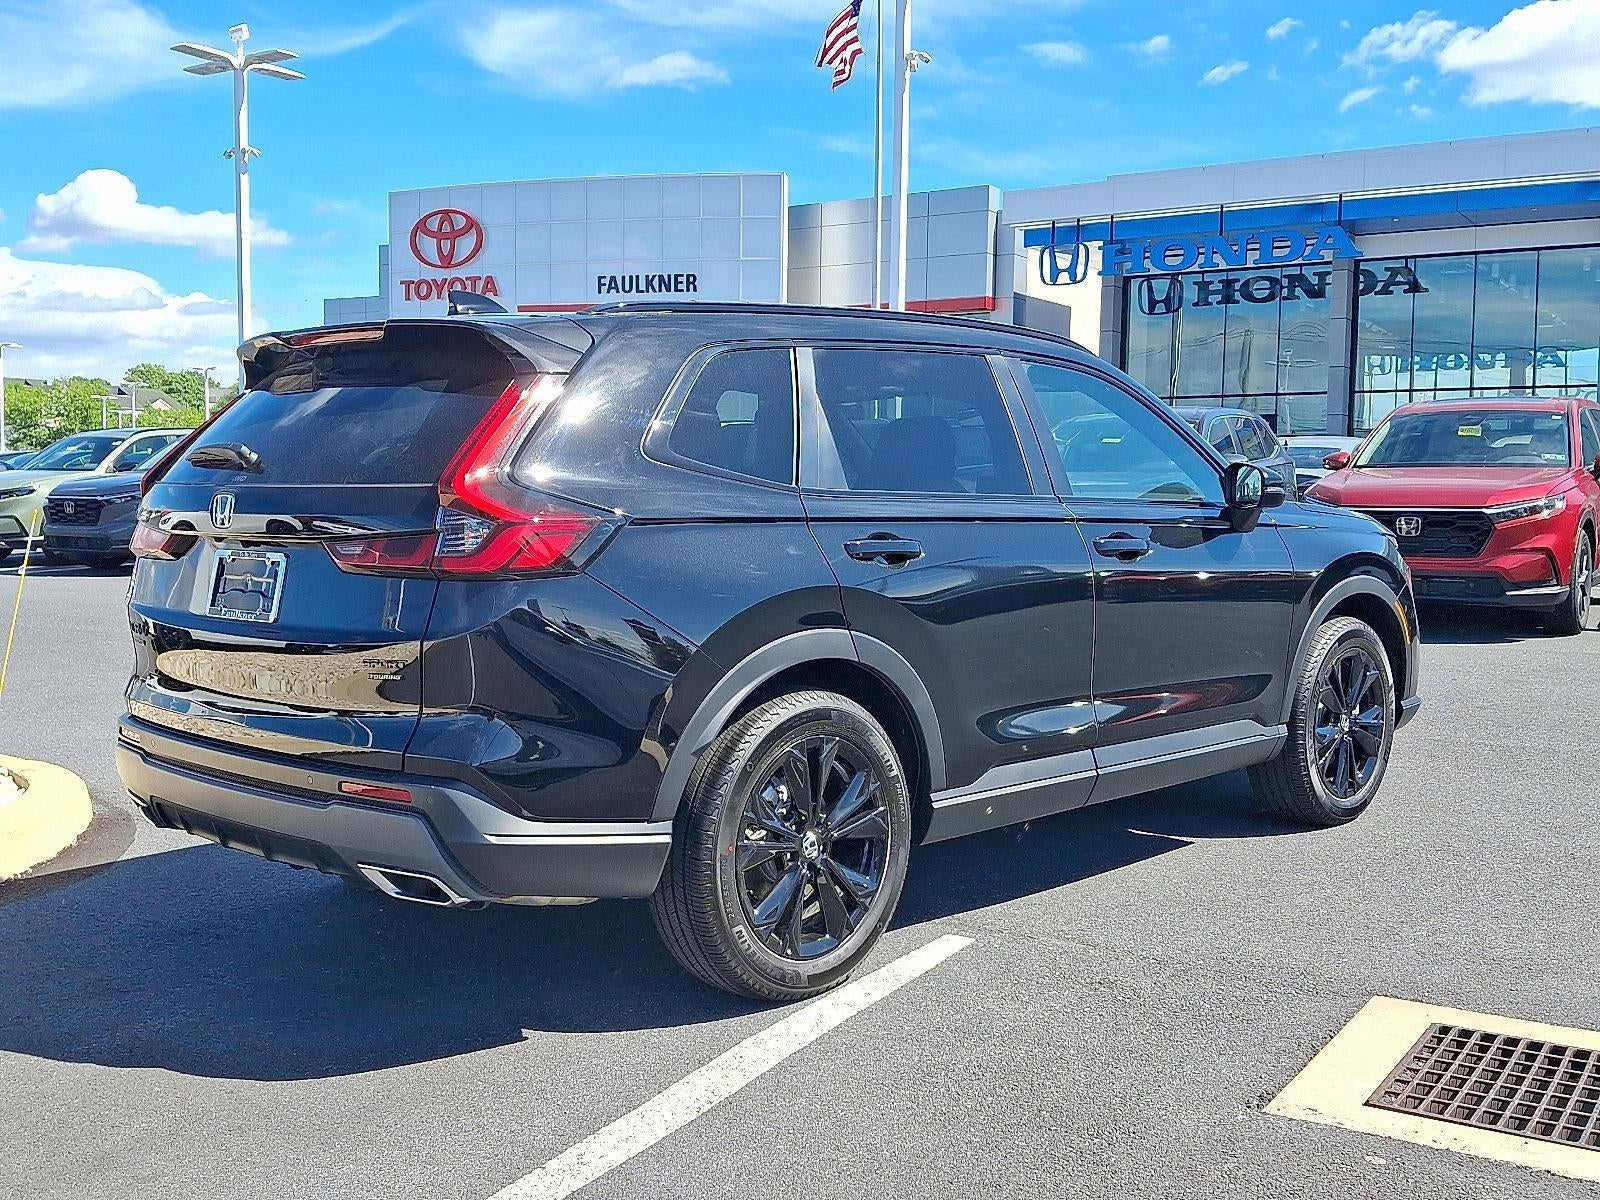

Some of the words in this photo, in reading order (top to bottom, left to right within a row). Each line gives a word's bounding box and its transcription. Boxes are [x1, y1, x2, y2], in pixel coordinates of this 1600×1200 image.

[1098, 225, 1363, 276] HONDA
[399, 275, 499, 301] TOYOTA
[597, 273, 698, 295] FAULKNER
[221, 609, 257, 620] Faulkner
